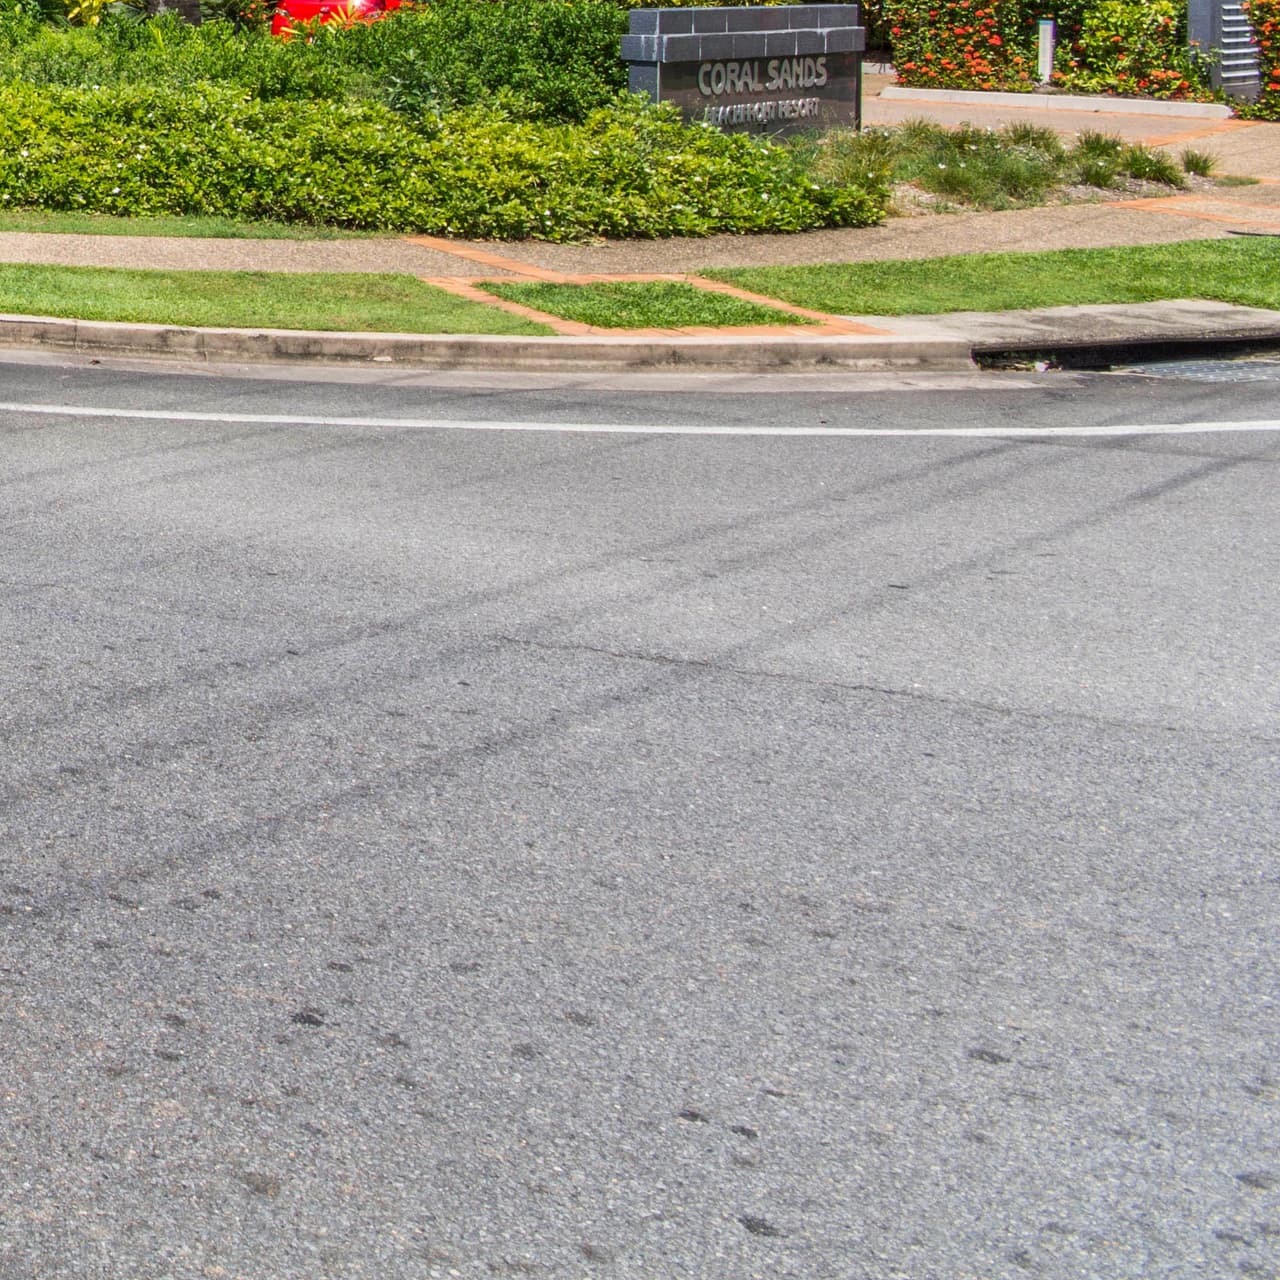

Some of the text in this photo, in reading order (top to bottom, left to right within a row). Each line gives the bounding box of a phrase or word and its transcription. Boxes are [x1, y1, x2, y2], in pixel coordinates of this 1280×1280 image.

[698, 56, 828, 96] CORAL SANDS
[779, 97, 819, 119] RESORT
